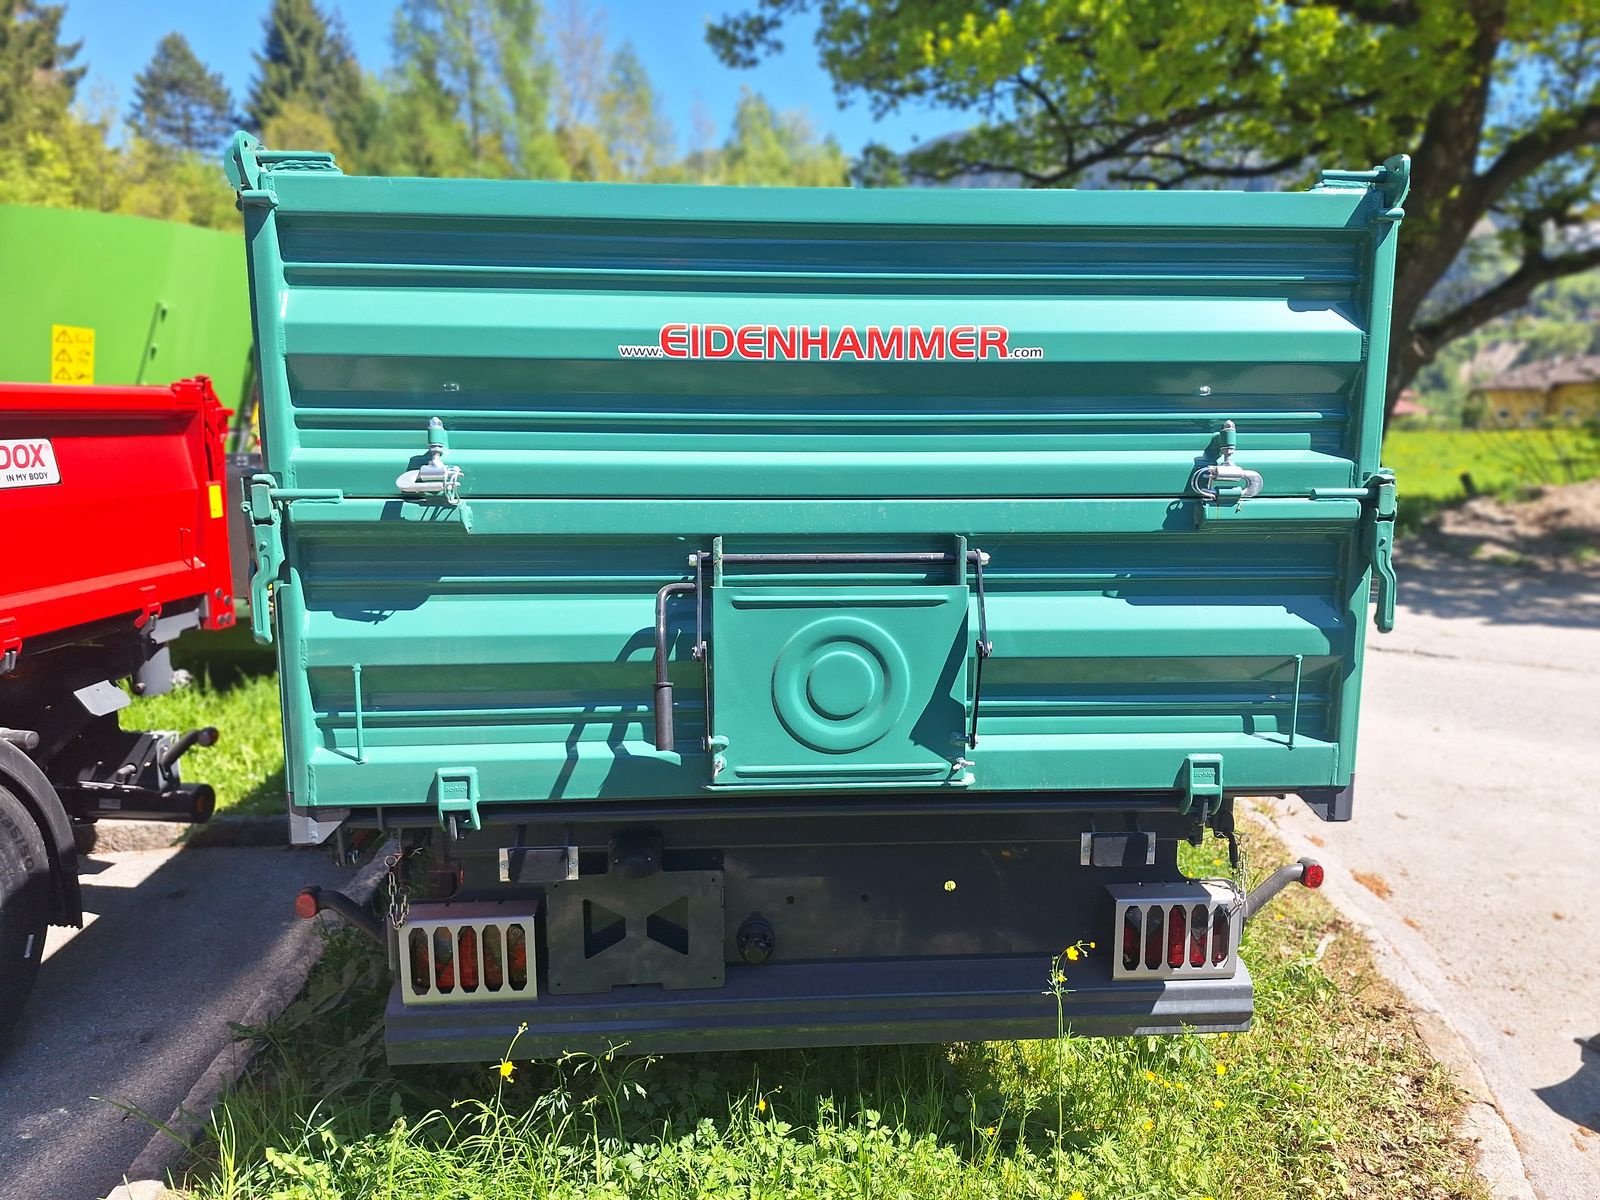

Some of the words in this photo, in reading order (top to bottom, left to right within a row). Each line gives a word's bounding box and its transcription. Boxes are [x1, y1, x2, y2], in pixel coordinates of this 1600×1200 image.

[618, 323, 1044, 361] www.EIDENHAMMER.com
[6, 474, 15, 482] IN
[16, 473, 27, 482] MY
[29, 472, 48, 481] BODY
